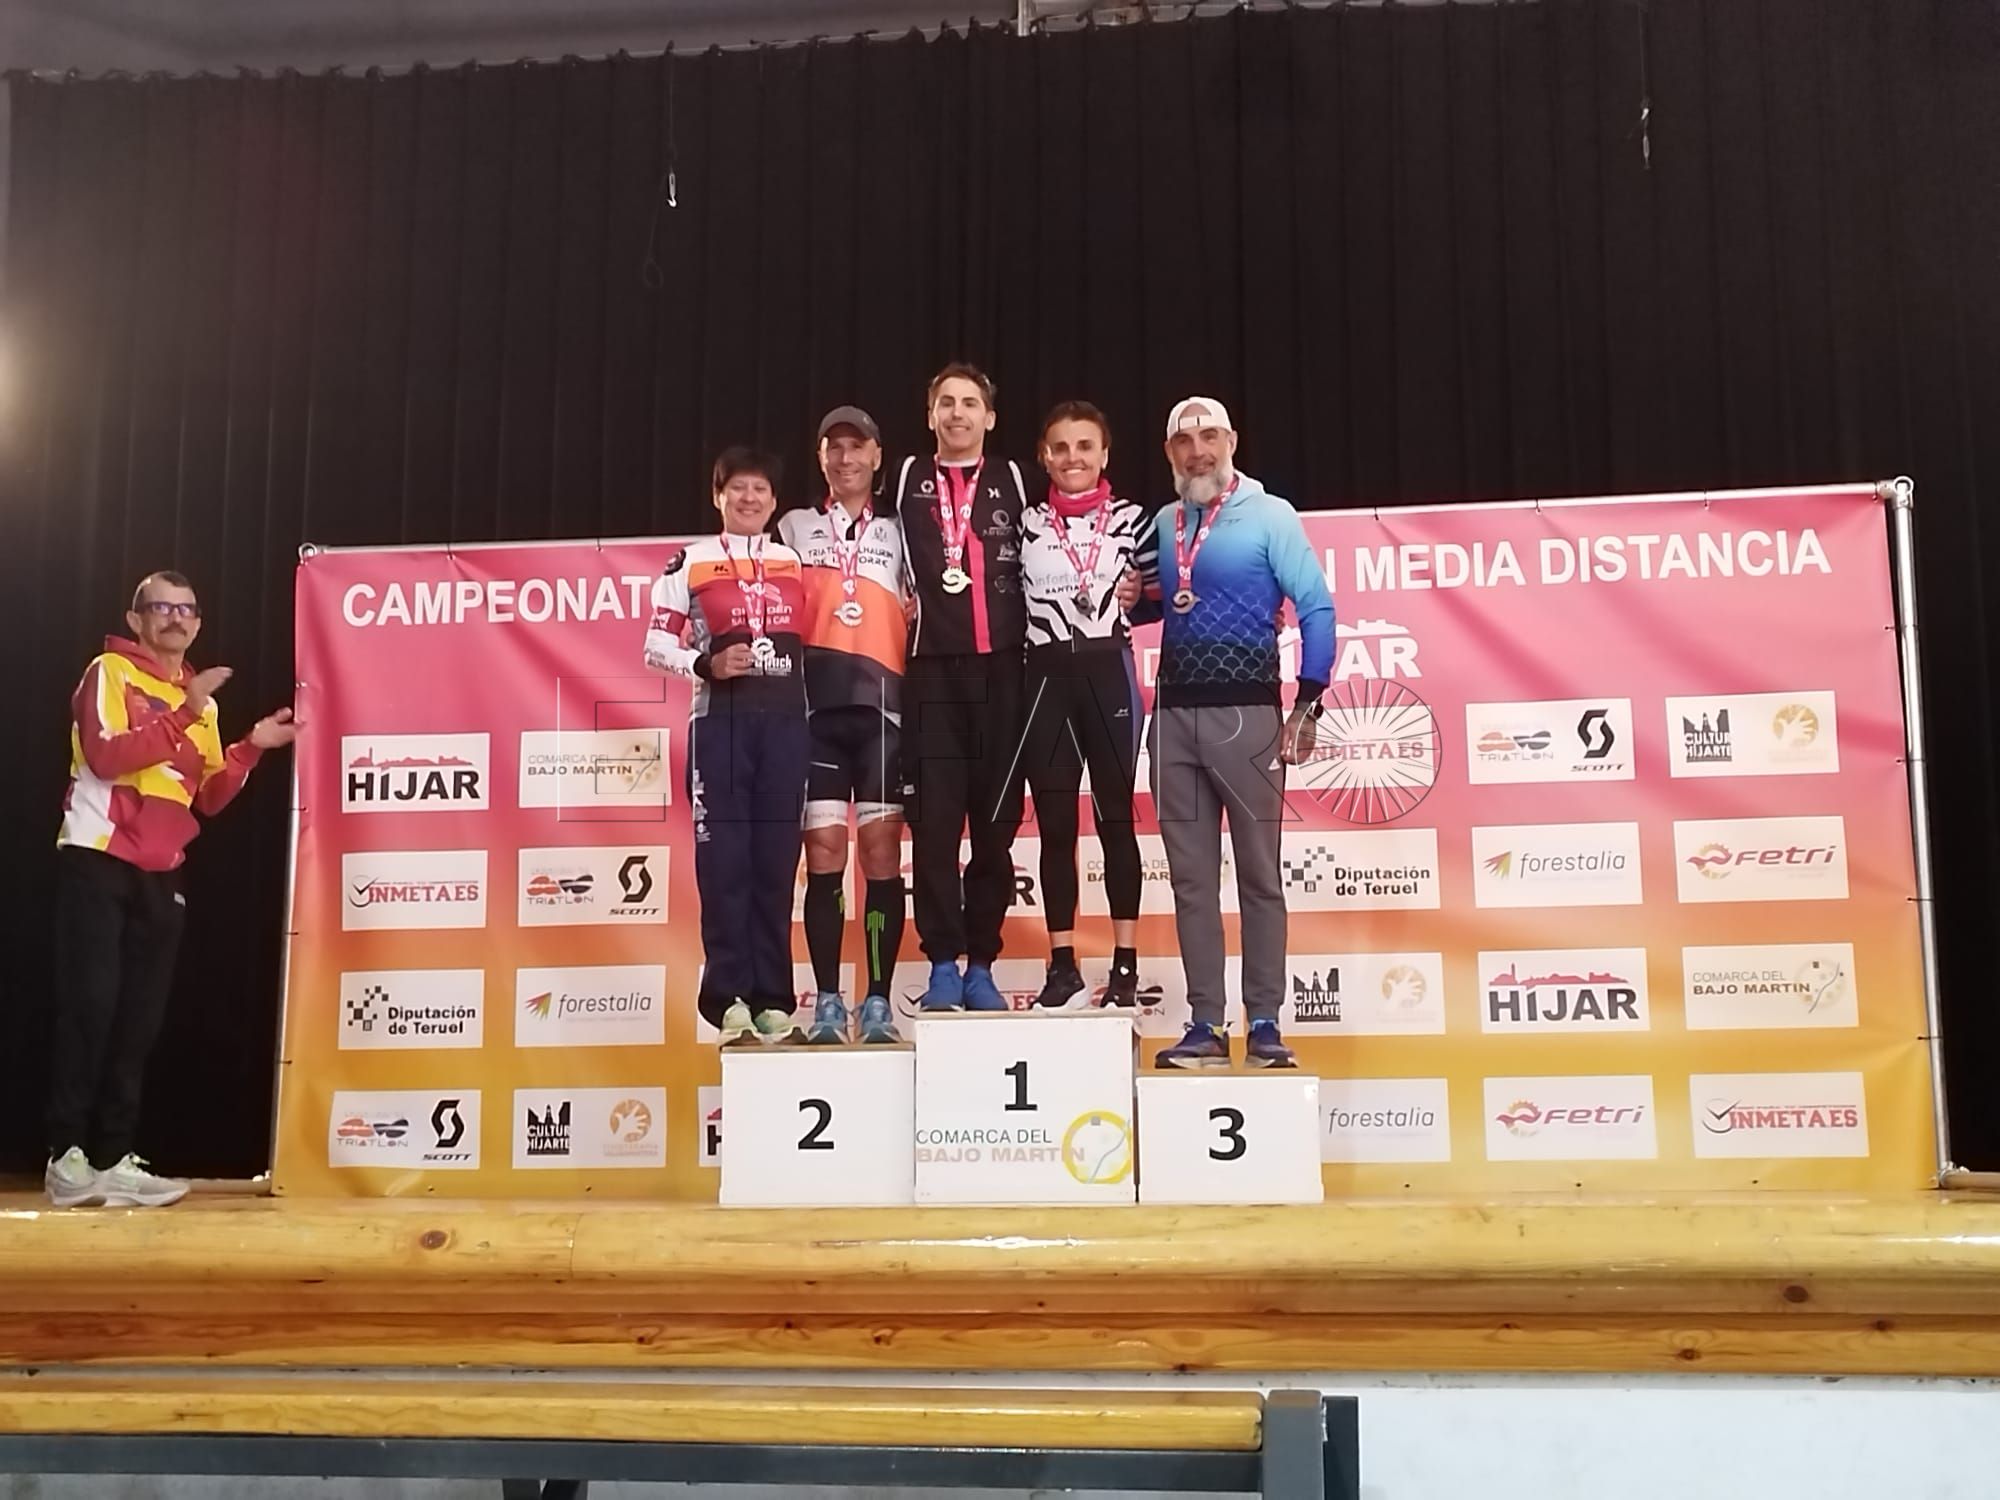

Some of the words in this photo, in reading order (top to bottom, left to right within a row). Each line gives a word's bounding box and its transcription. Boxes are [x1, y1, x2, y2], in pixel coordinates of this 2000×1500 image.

[858, 555, 888, 568] ORRE
[1355, 541, 1526, 592] MEDIA
[1540, 528, 1832, 585] DISTANCIA
[343, 576, 651, 627] CAMPEONAT
[528, 754, 588, 764] COMARCA
[1309, 742, 1424, 761] NMETAES
[527, 765, 568, 776] BAJO
[572, 763, 633, 776] MARTIN
[1570, 763, 1624, 773] SCOTT
[1520, 851, 1626, 879] forestalia
[1334, 866, 1431, 885] Diputación
[368, 884, 480, 904] INMETAES
[1335, 883, 1357, 896] de
[1364, 881, 1418, 896] Teruel
[608, 907, 660, 916] SCOTT
[1692, 971, 1760, 983] COMARCA
[1762, 971, 1786, 982] DEL
[1693, 983, 1738, 995] BAJO
[1744, 982, 1811, 995] MARTIN
[388, 1005, 476, 1024] Diputación
[558, 992, 652, 1019] forestalia
[388, 1022, 408, 1035] de
[413, 1021, 464, 1035] Teruel
[1004, 1061, 1038, 1112] 1
[798, 1098, 835, 1150] 2
[1329, 1106, 1435, 1134] forestalia
[1730, 1108, 1858, 1129] INMETAES
[916, 1129, 1011, 1144] COMARCA
[1017, 1129, 1053, 1143] DEL
[1208, 1107, 1247, 1160] 3
[422, 1153, 472, 1161] SCOTT
[916, 1147, 981, 1163] BAJO
